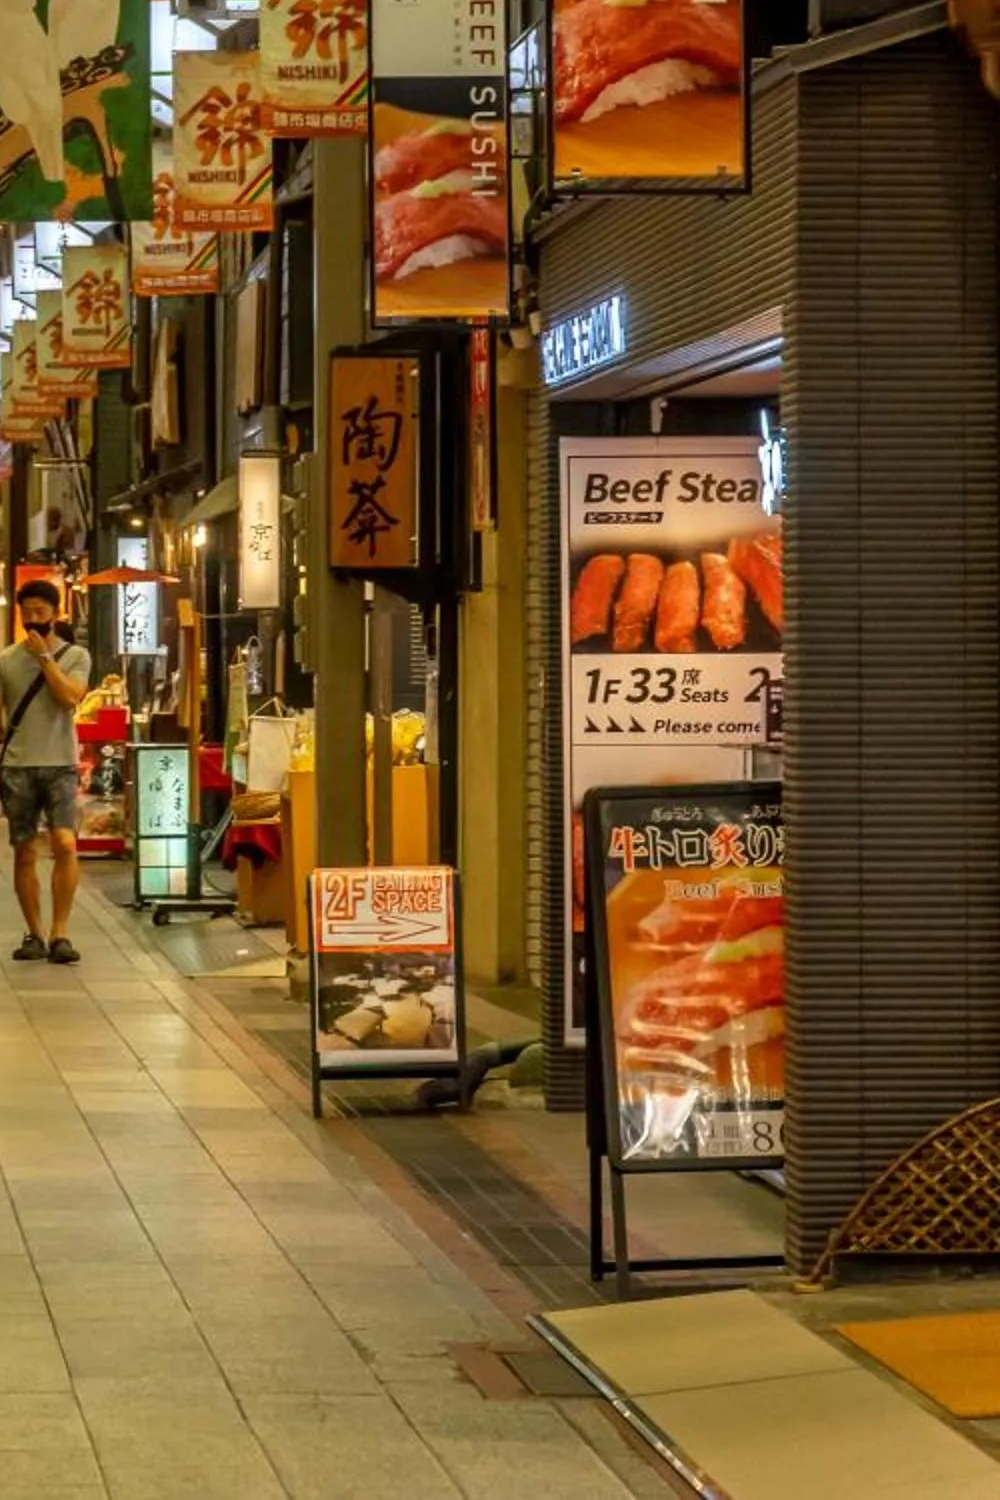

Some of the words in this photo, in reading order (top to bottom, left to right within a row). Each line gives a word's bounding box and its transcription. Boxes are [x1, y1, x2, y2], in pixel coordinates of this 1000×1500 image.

[277, 65, 338, 81] NISHIKI
[470, 85, 499, 198] SUSHI
[187, 170, 238, 185] NISHIKI
[584, 470, 673, 504] Beef
[677, 470, 760, 504] Stea
[585, 667, 622, 704] 1F
[626, 667, 678, 704] 33
[681, 667, 702, 686] 席
[680, 687, 730, 704] Seats
[653, 719, 713, 734] Please
[608, 822, 785, 873] 牛トロ炙り
[325, 873, 369, 920] 2F
[372, 892, 443, 914] SPACE
